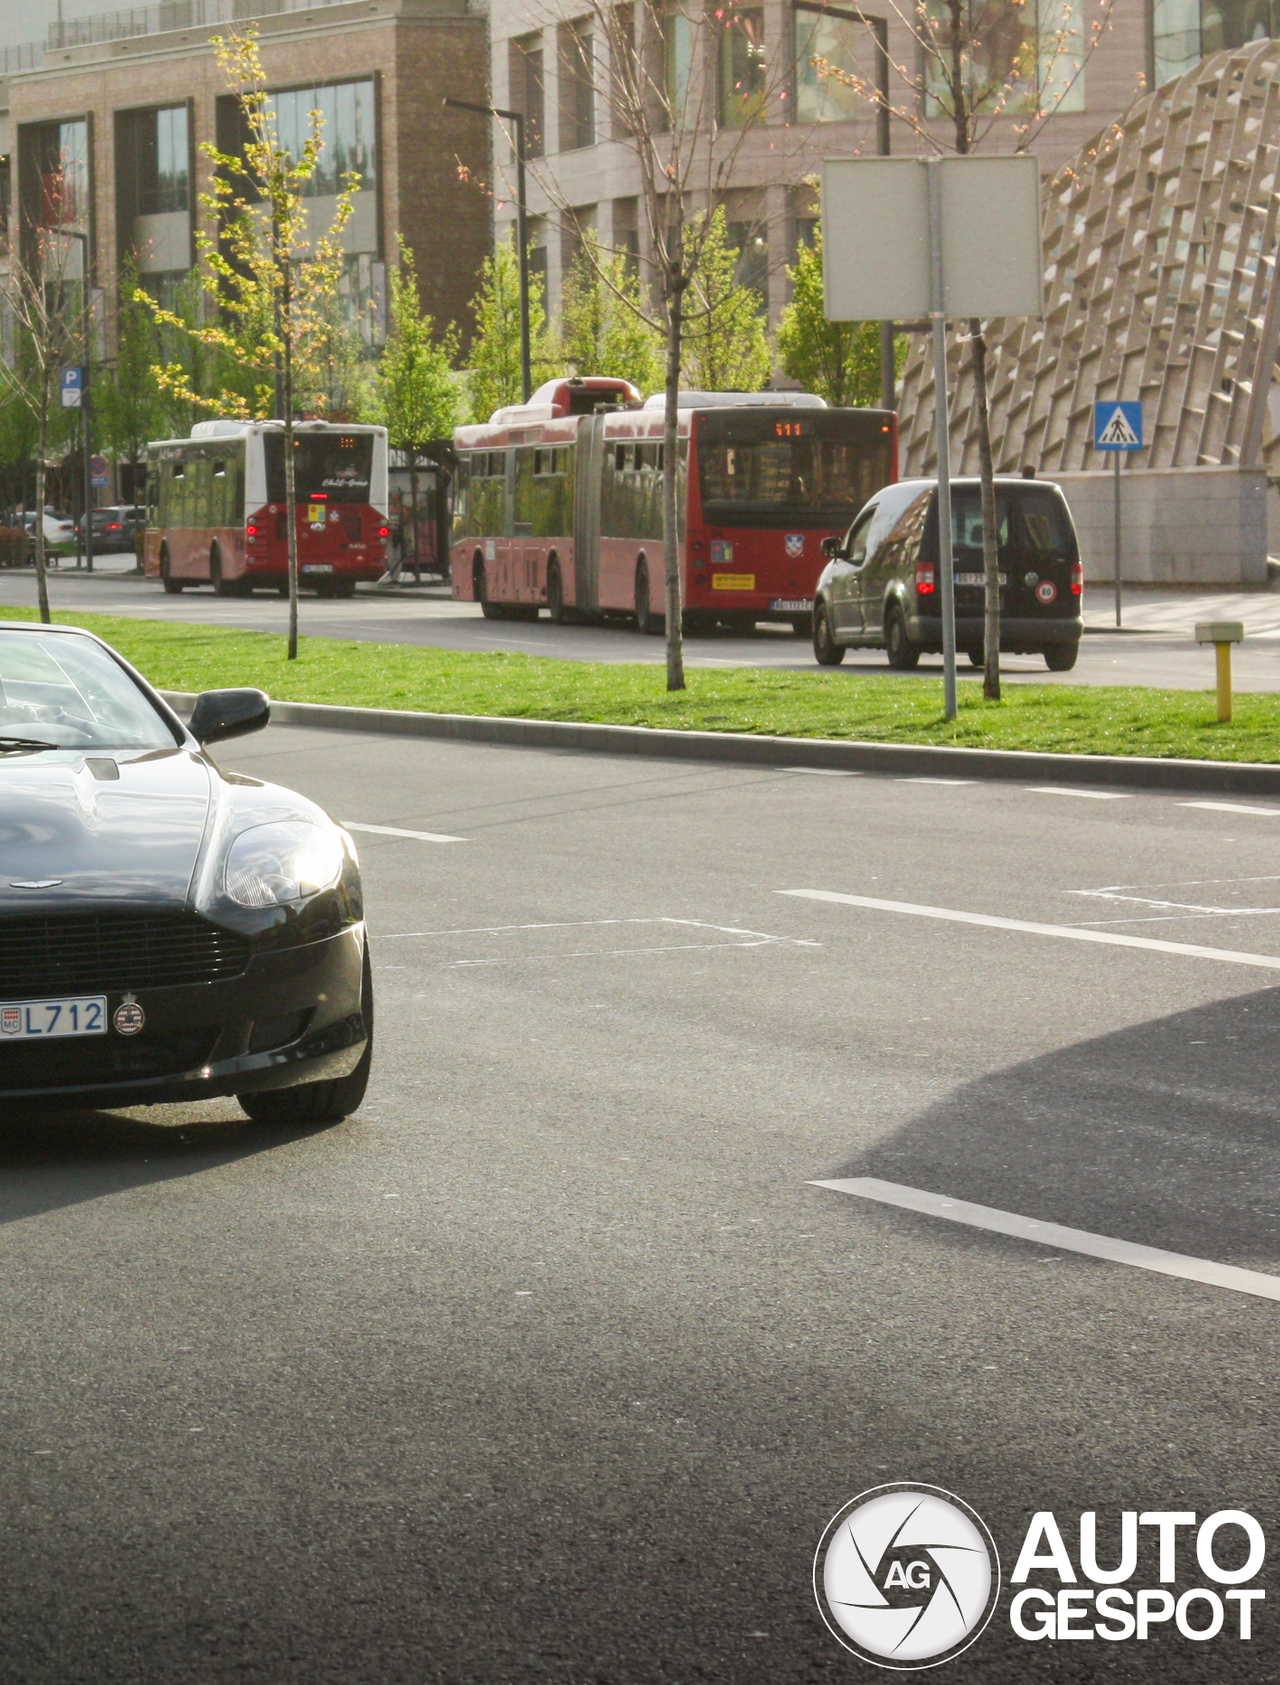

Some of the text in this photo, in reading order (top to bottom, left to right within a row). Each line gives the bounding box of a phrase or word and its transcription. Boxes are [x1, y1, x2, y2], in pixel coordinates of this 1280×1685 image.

[1041, 588, 1052, 597] 80
[26, 1002, 102, 1034] L712
[3, 1021, 19, 1029] MC
